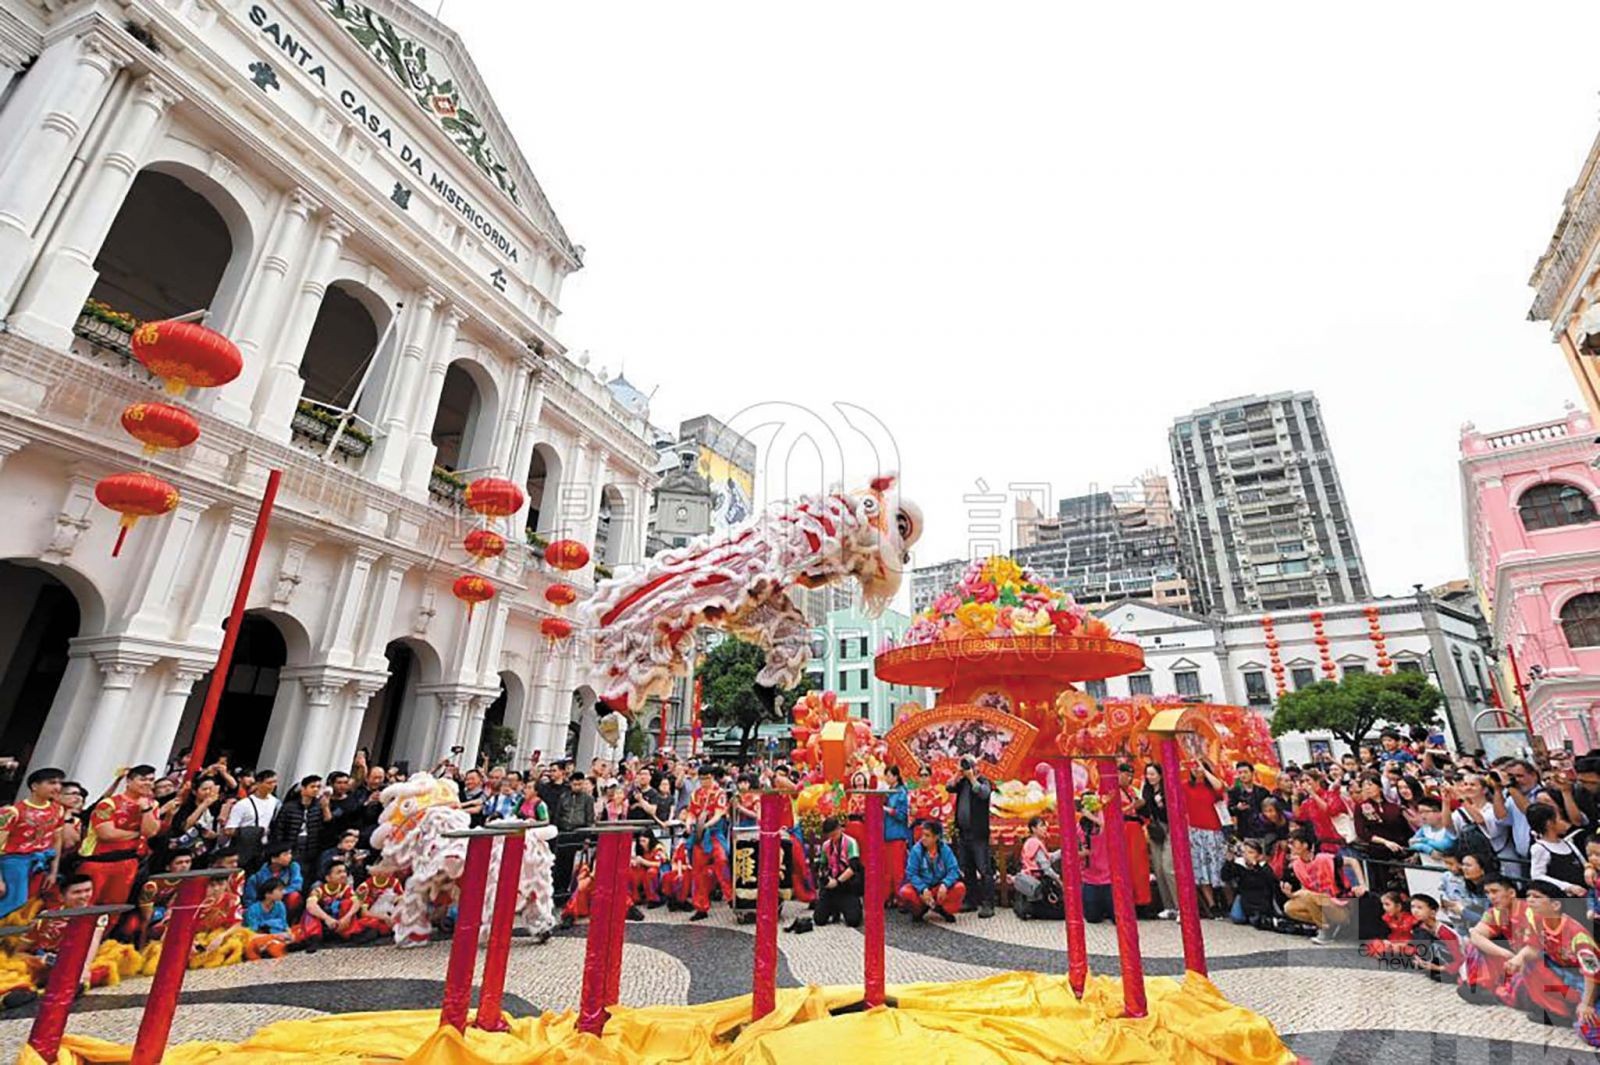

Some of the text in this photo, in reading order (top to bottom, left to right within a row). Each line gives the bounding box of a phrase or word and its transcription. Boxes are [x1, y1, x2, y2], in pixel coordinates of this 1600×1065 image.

[248, 4, 519, 264] SANTA CASA DA MISERICORDIA
[490, 267, 507, 292] 仁
